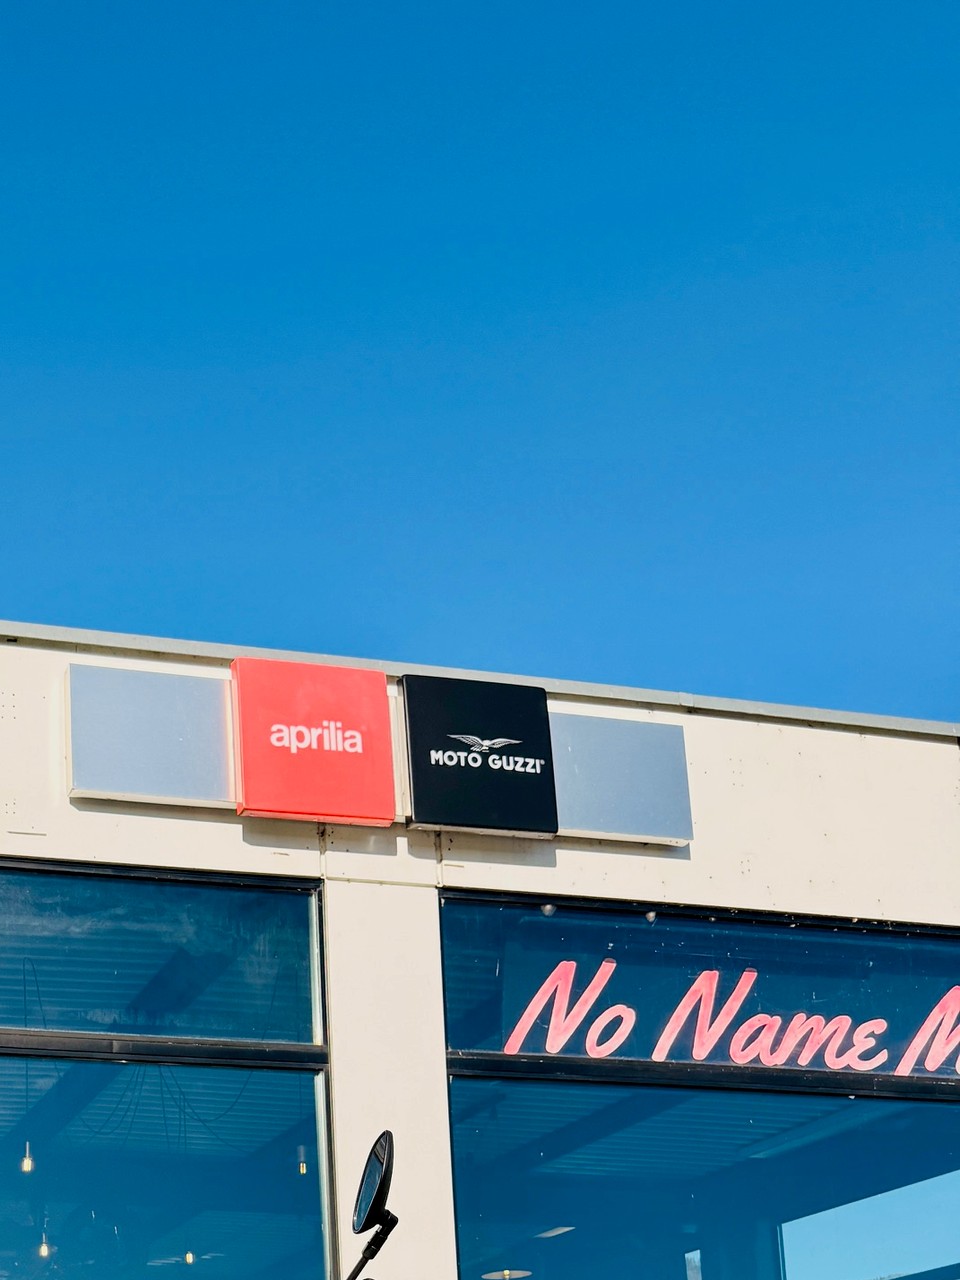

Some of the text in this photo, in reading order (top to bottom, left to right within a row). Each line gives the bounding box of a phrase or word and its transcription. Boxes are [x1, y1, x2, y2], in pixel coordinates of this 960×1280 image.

[270, 720, 363, 754] aprilia
[430, 749, 541, 774] MOTO GUZZI
[504, 958, 636, 1059] No
[652, 968, 888, 1071] Name
